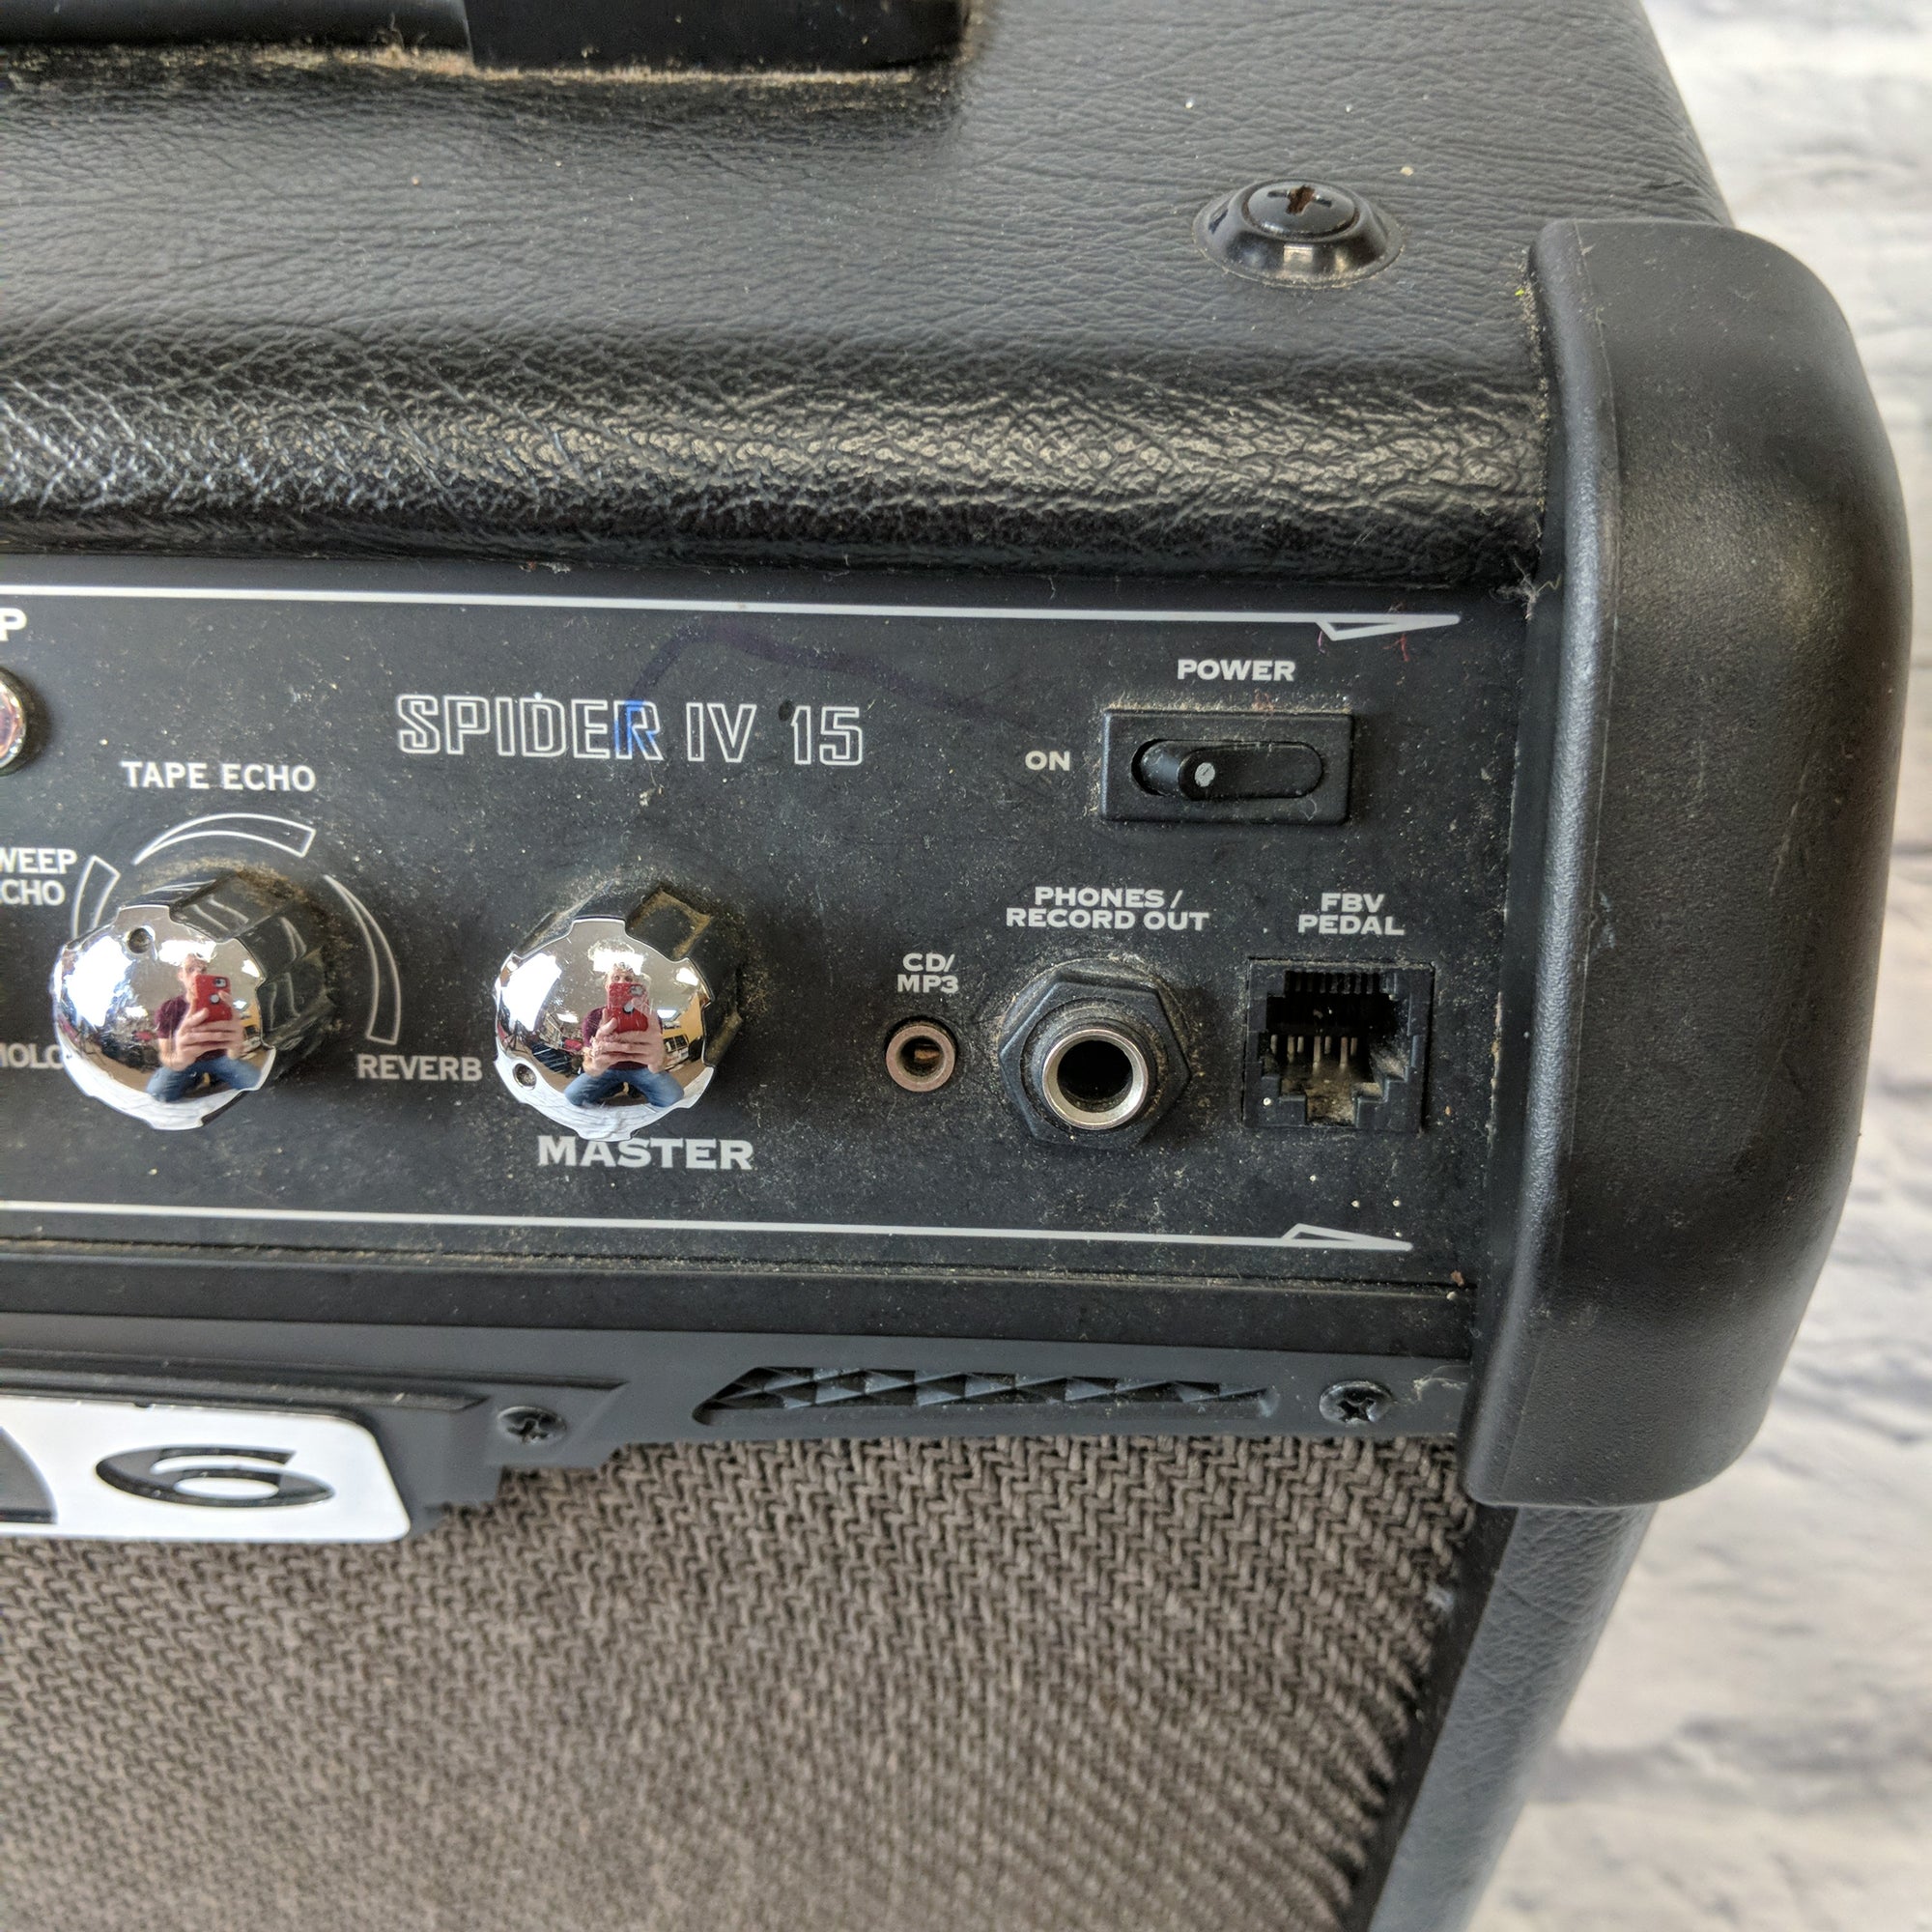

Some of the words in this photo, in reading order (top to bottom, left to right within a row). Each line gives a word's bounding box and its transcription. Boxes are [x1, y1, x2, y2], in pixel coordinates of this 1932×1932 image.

[1177, 659, 1296, 681] POWER
[396, 694, 664, 760] SPIDER
[686, 702, 756, 763] IV
[790, 705, 863, 766] 15
[1024, 751, 1070, 772] ON
[121, 760, 212, 789] TAPE
[222, 764, 316, 792] ECHO
[1321, 893, 1385, 912] FBV
[1006, 907, 1136, 929] RECORD
[1143, 911, 1209, 931] OUT
[1297, 914, 1405, 936] PEDAL
[902, 952, 955, 974] CD/
[896, 974, 959, 994] MP3
[356, 1054, 483, 1081] REVERB
[537, 1134, 754, 1170] MASTER
[95, 1443, 336, 1509] 6
